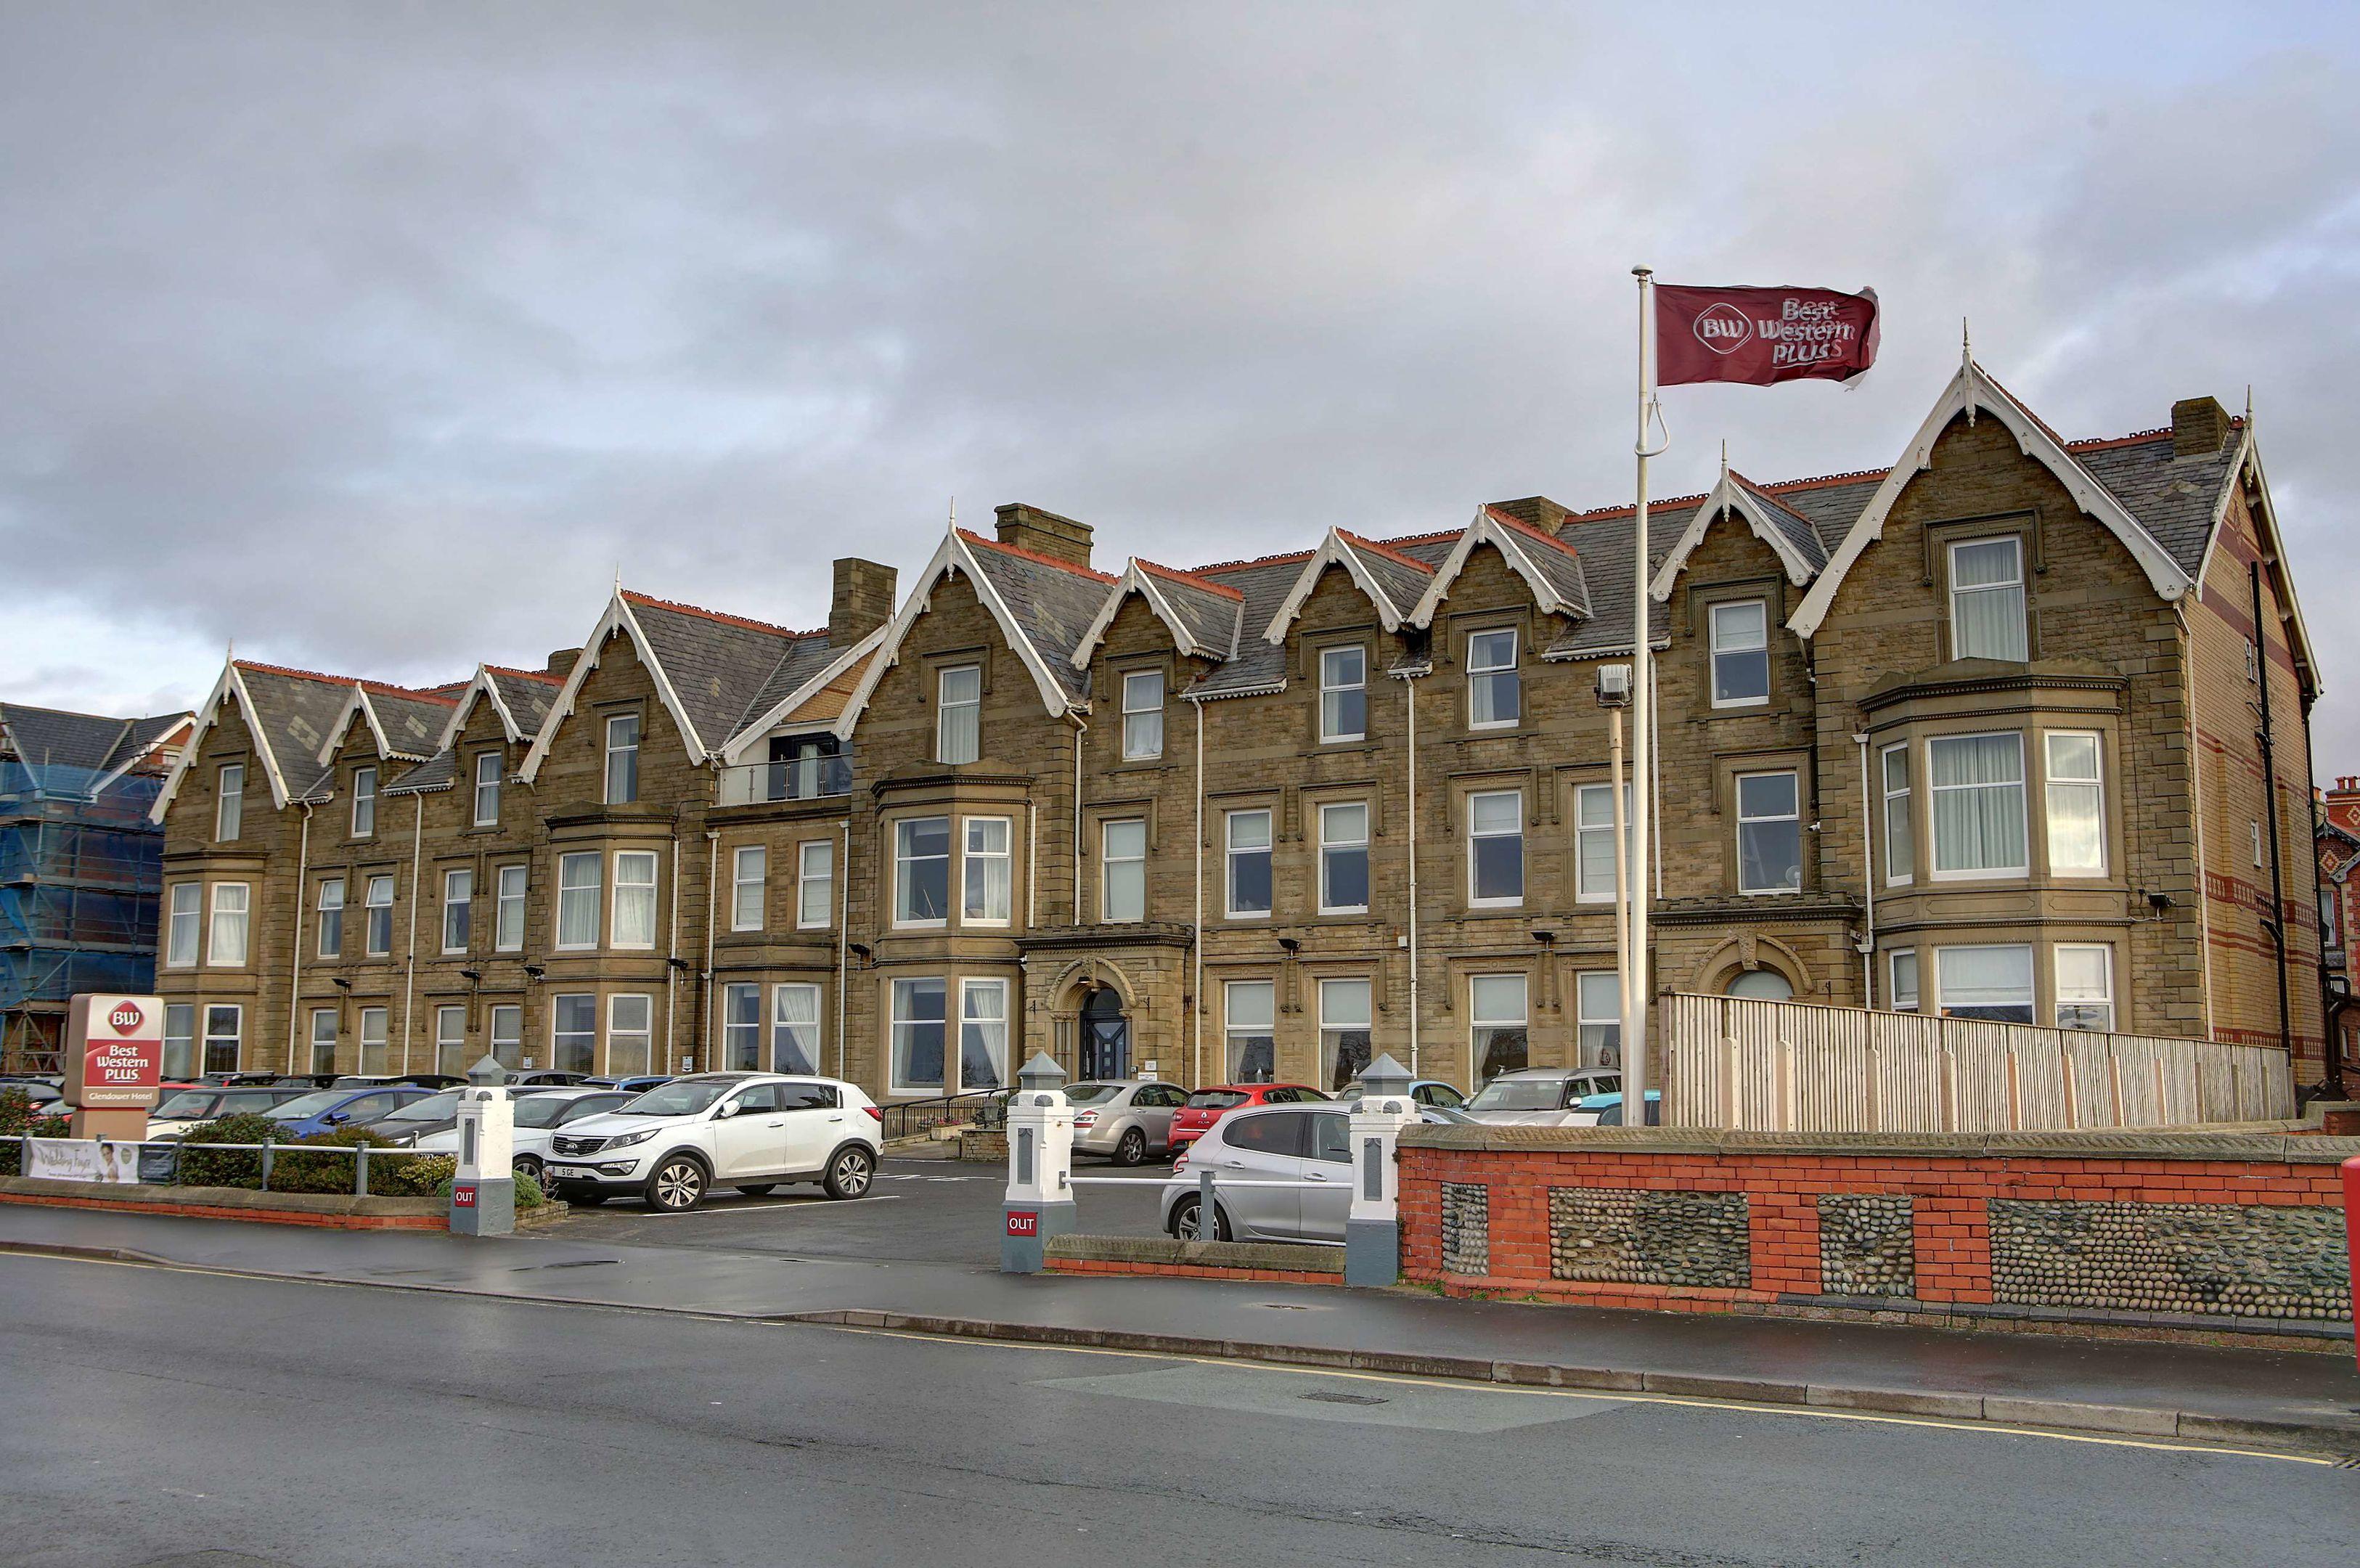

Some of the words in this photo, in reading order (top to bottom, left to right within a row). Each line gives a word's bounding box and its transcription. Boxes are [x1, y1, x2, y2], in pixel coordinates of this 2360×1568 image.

[1783, 298, 1839, 321] Best
[1702, 319, 1744, 338] BW
[1757, 319, 1855, 342] Western
[1772, 341, 1839, 364] PLUS
[113, 1011, 140, 1026] BW
[109, 1045, 139, 1056] Best
[97, 1056, 149, 1067] Western
[456, 1191, 474, 1201] OUT
[1009, 1217, 1034, 1230] OUT
